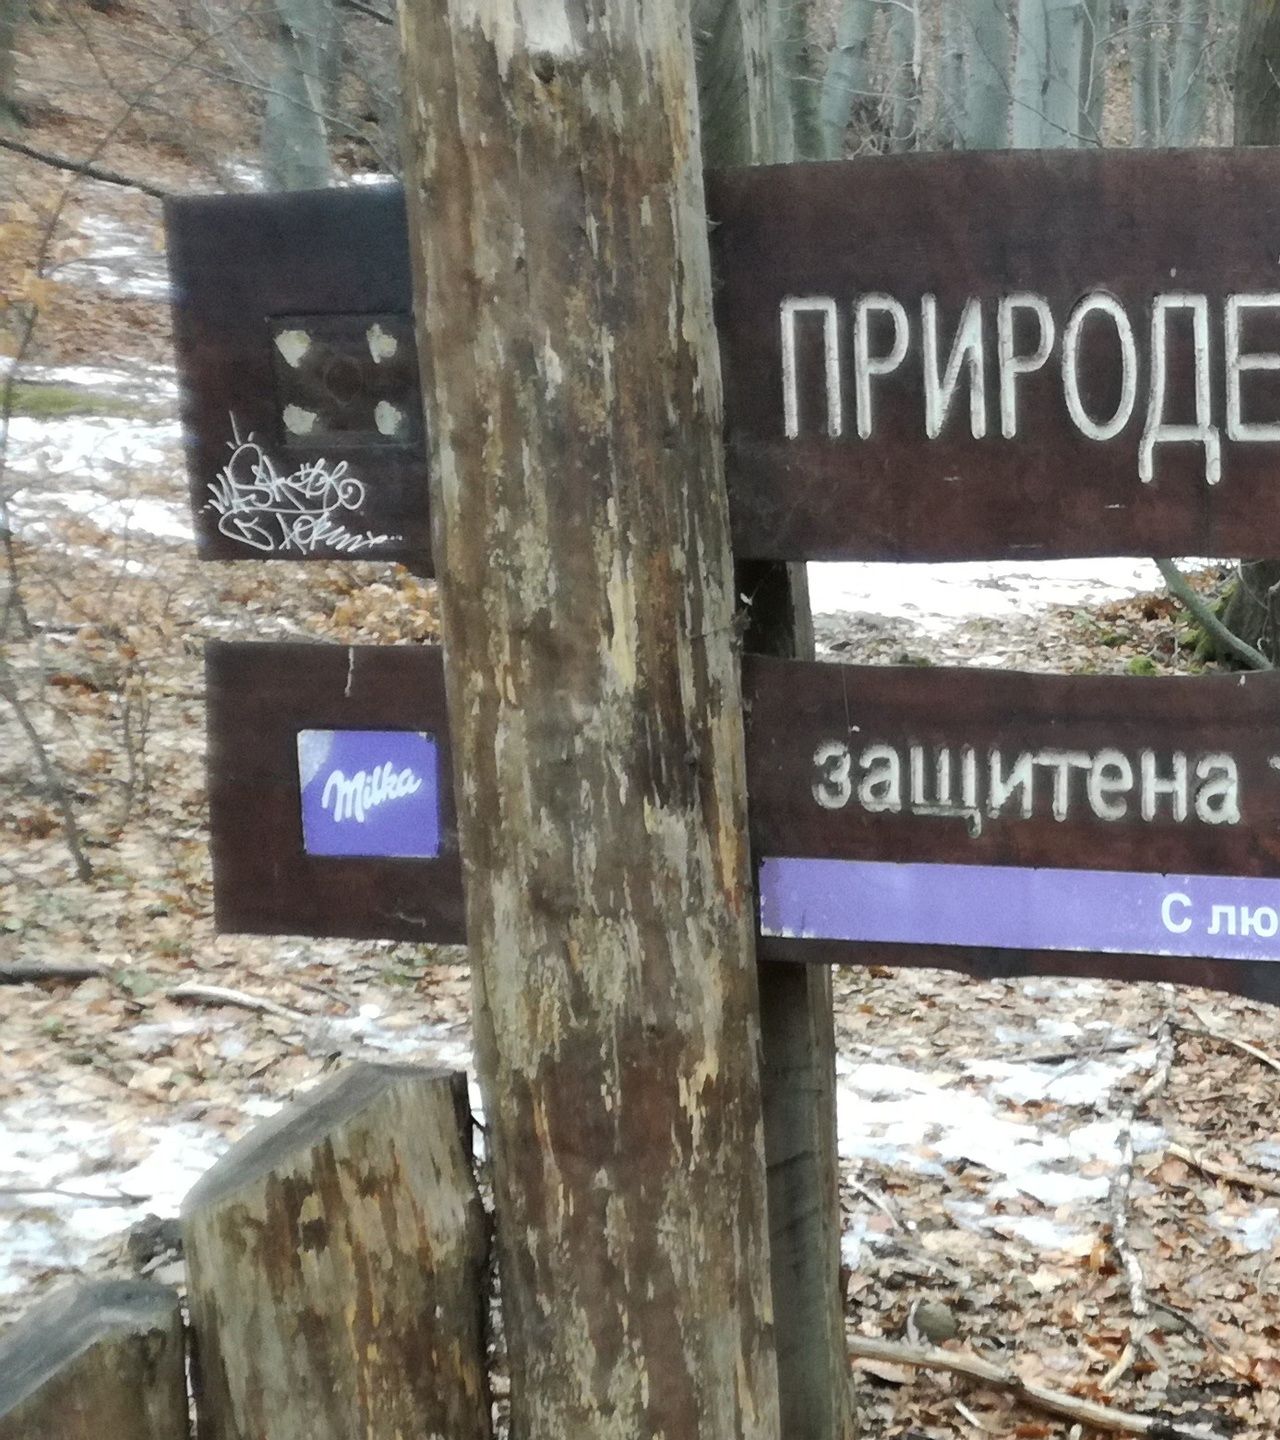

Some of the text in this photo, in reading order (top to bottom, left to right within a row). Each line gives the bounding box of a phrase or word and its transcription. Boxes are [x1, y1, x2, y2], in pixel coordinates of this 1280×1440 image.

[321, 760, 423, 824] Milka
[811, 741, 1241, 838] защитена
[1161, 892, 1193, 934] С
